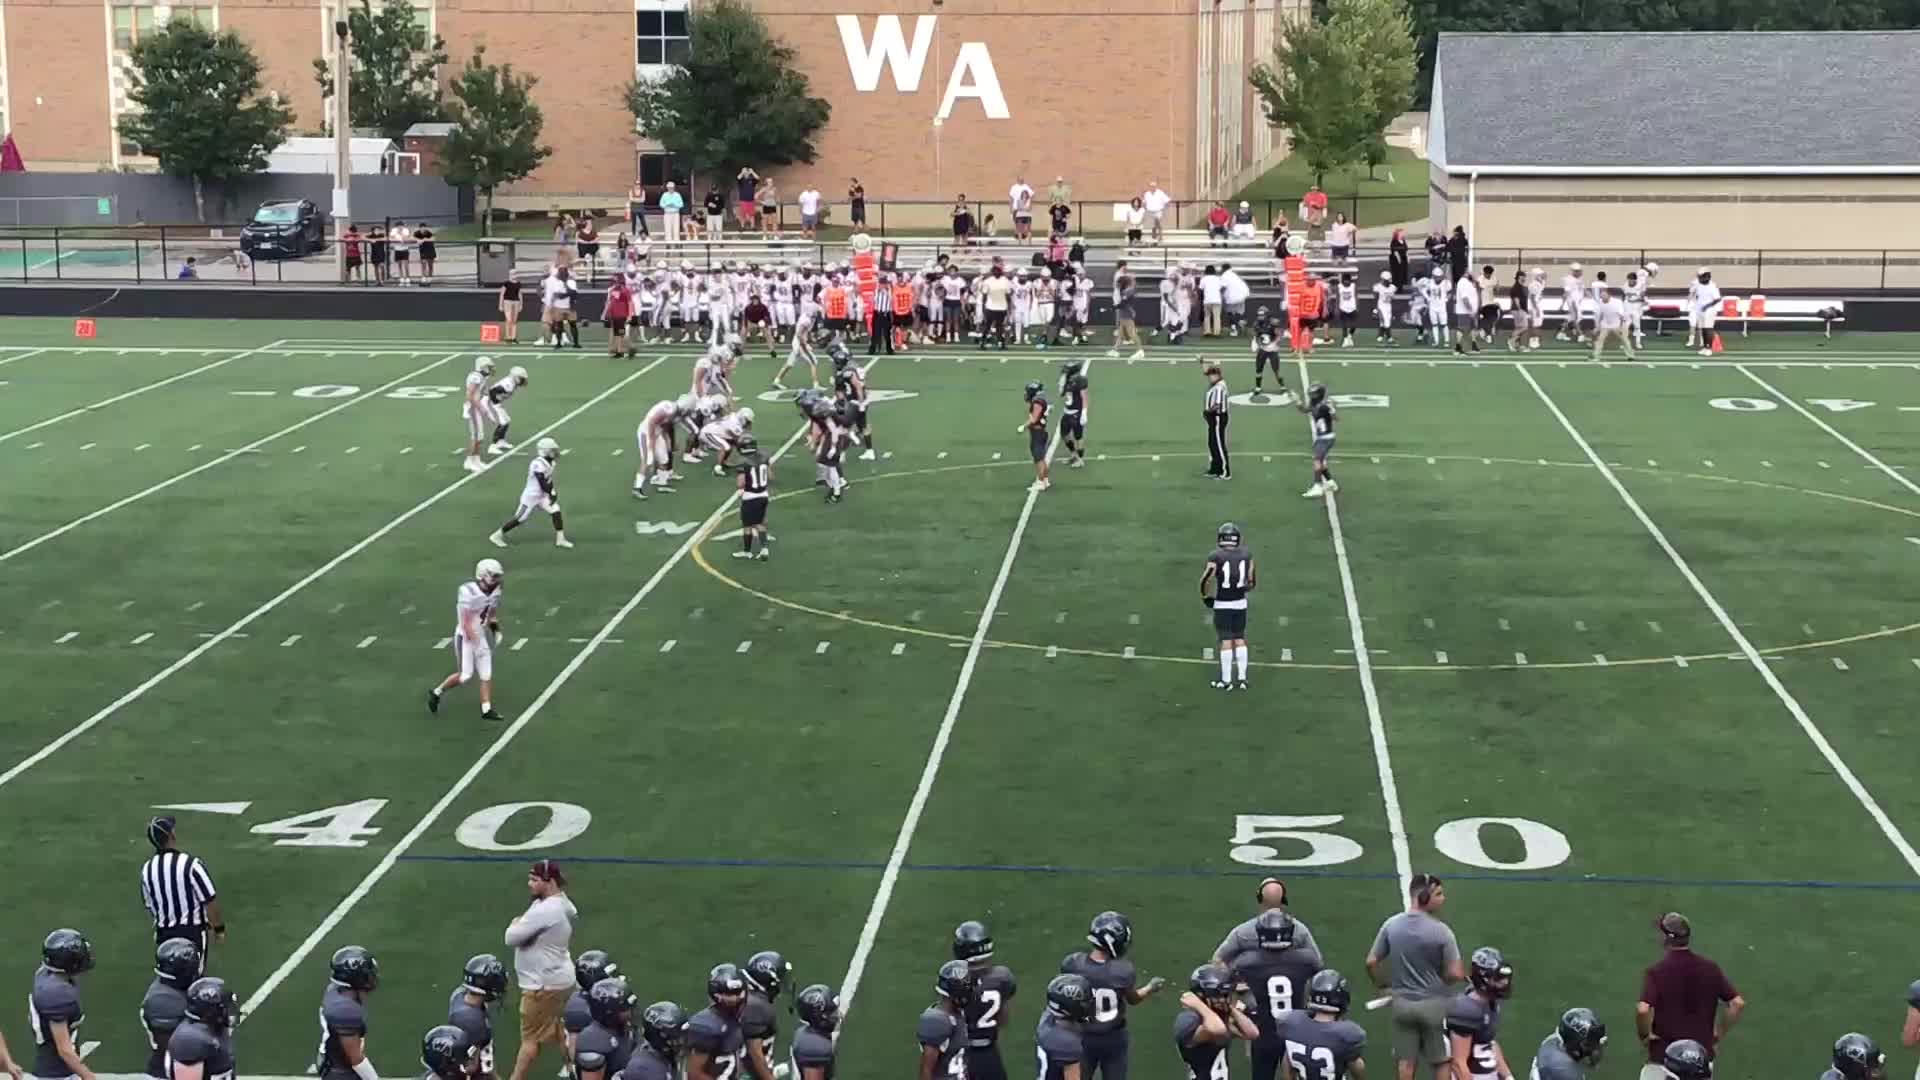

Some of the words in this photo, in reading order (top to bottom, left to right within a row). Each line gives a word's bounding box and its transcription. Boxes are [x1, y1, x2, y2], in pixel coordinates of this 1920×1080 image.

[835, 14, 1011, 119] WA
[750, 463, 769, 489] 10
[1221, 559, 1247, 588] 11
[977, 990, 1002, 1029] 2
[1266, 975, 1294, 1020] 8
[1285, 1038, 1336, 1080] 53
